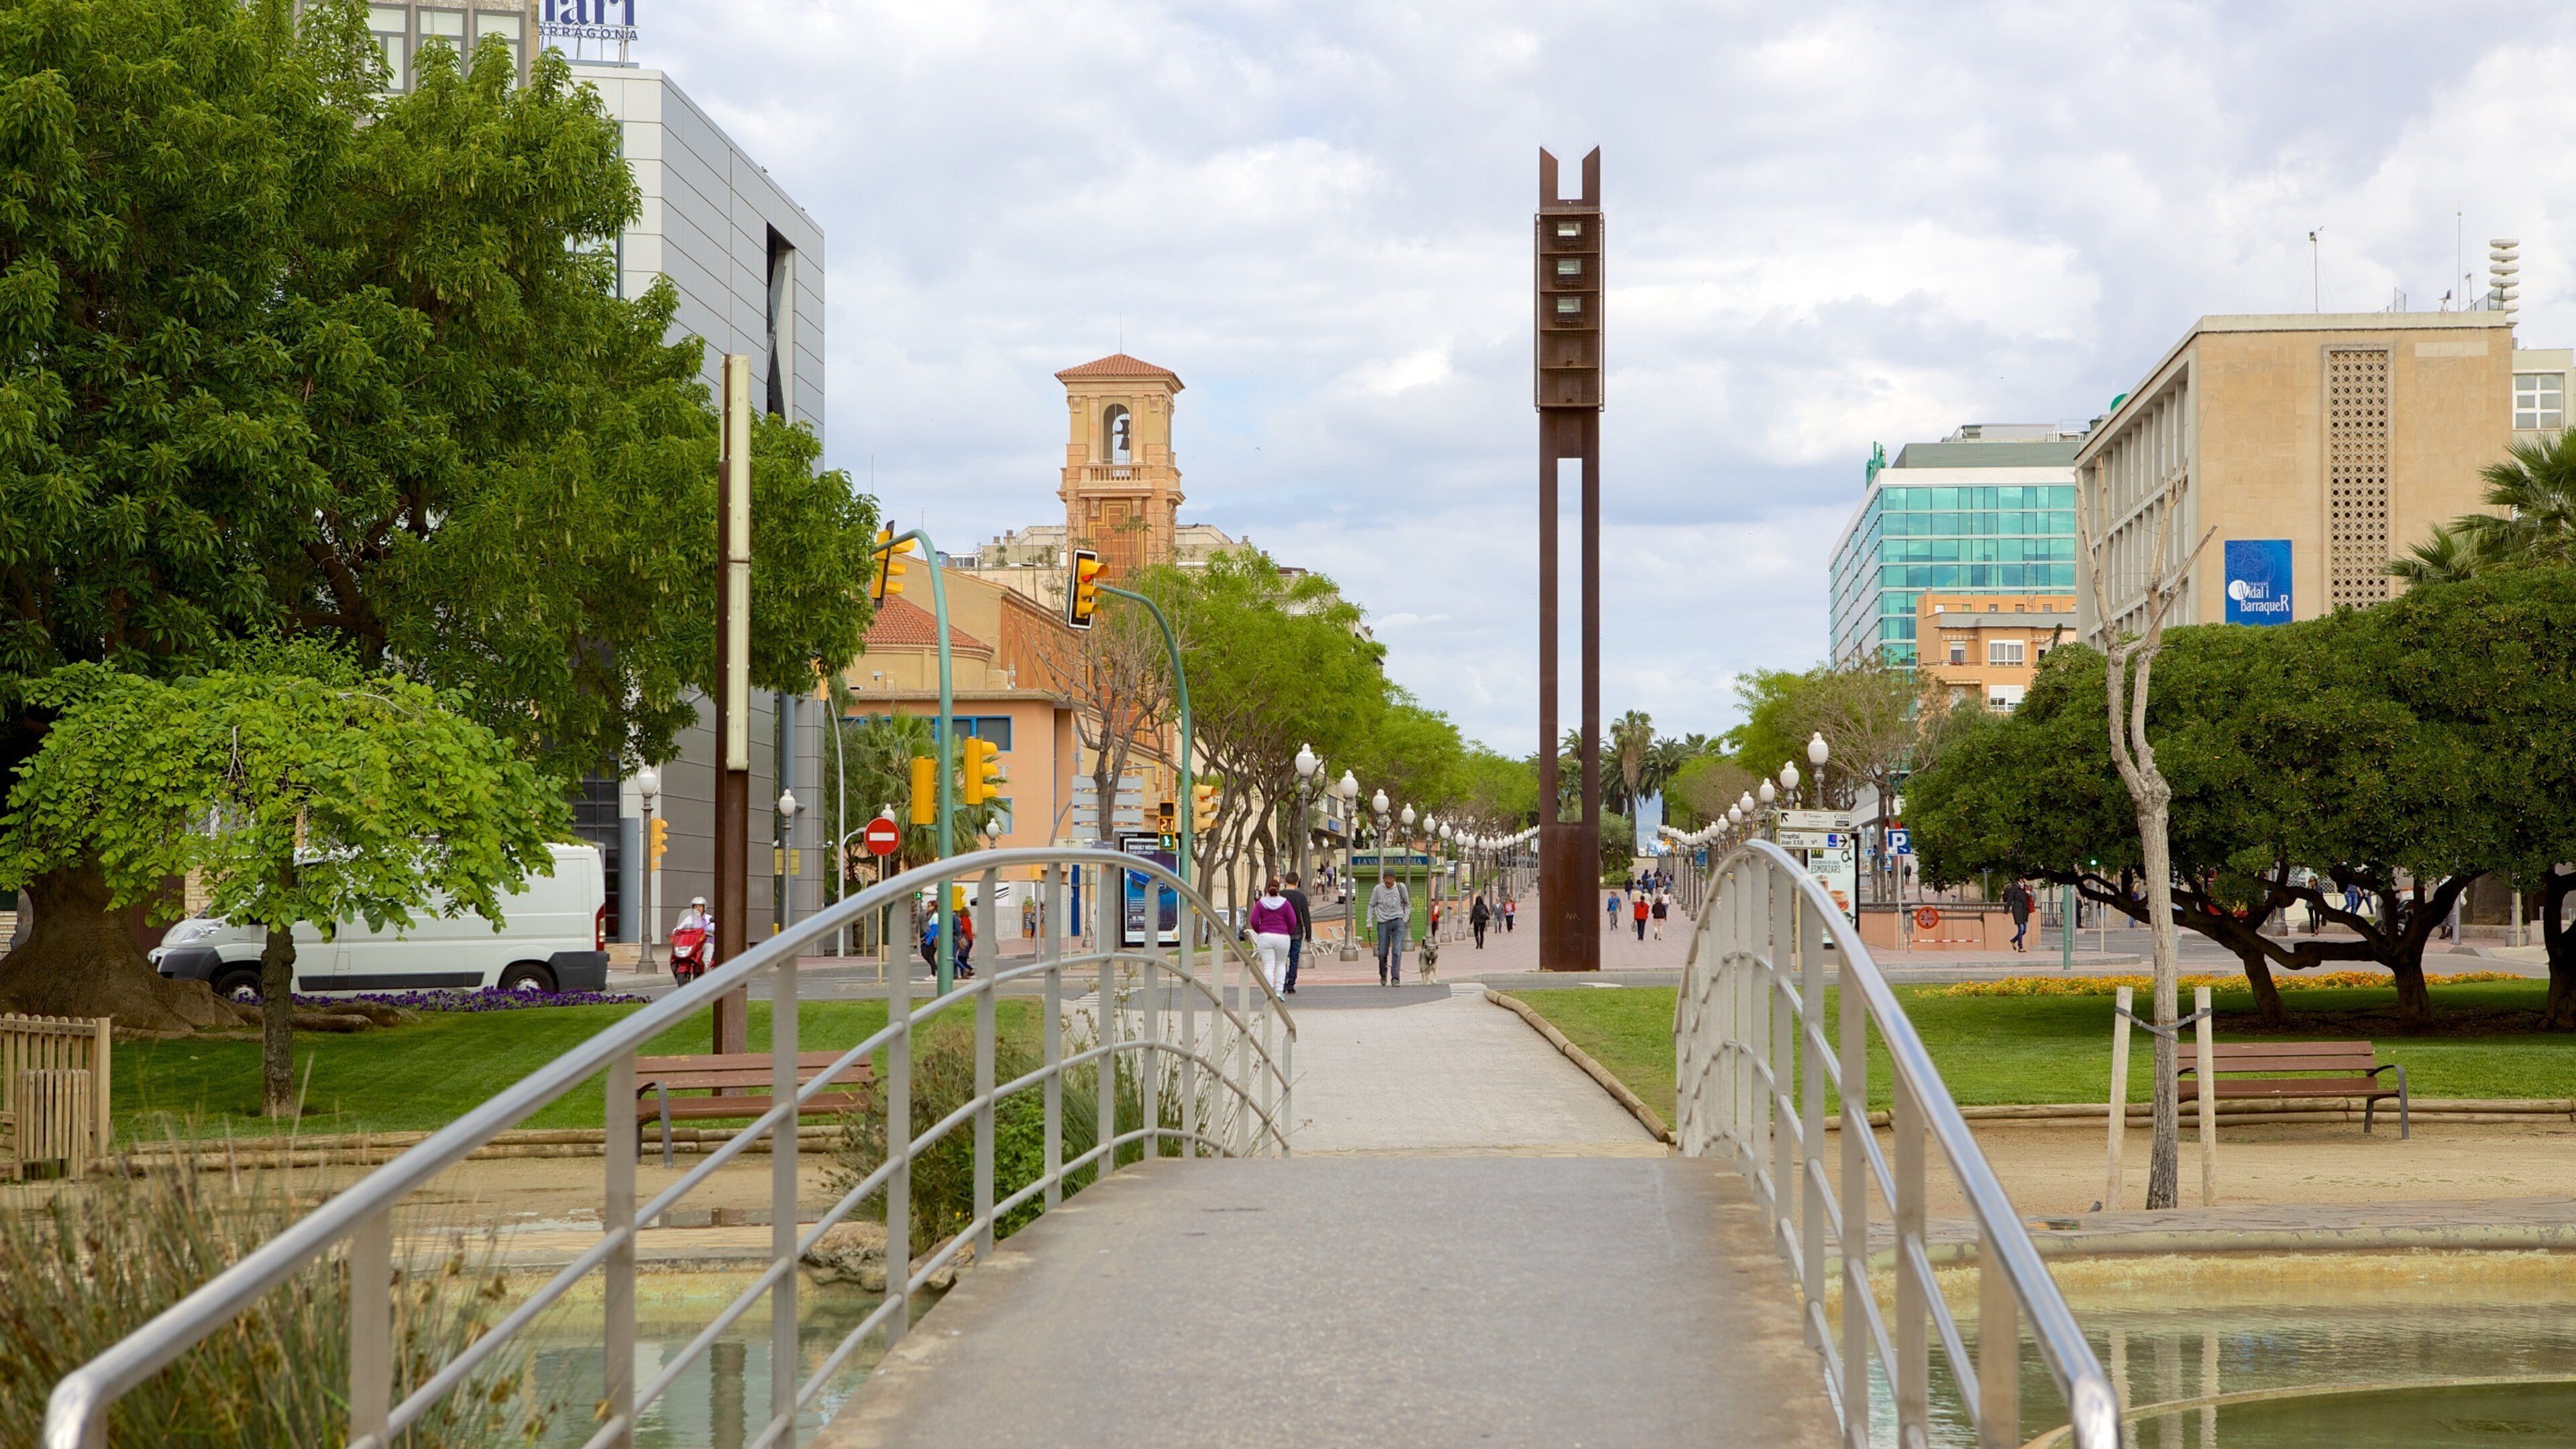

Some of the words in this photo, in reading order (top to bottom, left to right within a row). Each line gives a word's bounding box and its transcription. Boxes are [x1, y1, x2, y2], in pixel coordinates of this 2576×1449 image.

[545, 0, 635, 26] iari
[539, 25, 638, 40] ARRAGONA
[2239, 582, 2264, 598] Vidal
[2266, 586, 2269, 598] i
[1161, 819, 1173, 832] 21
[1892, 833, 1907, 854] P
[1811, 865, 1841, 873] ESMORZARS
